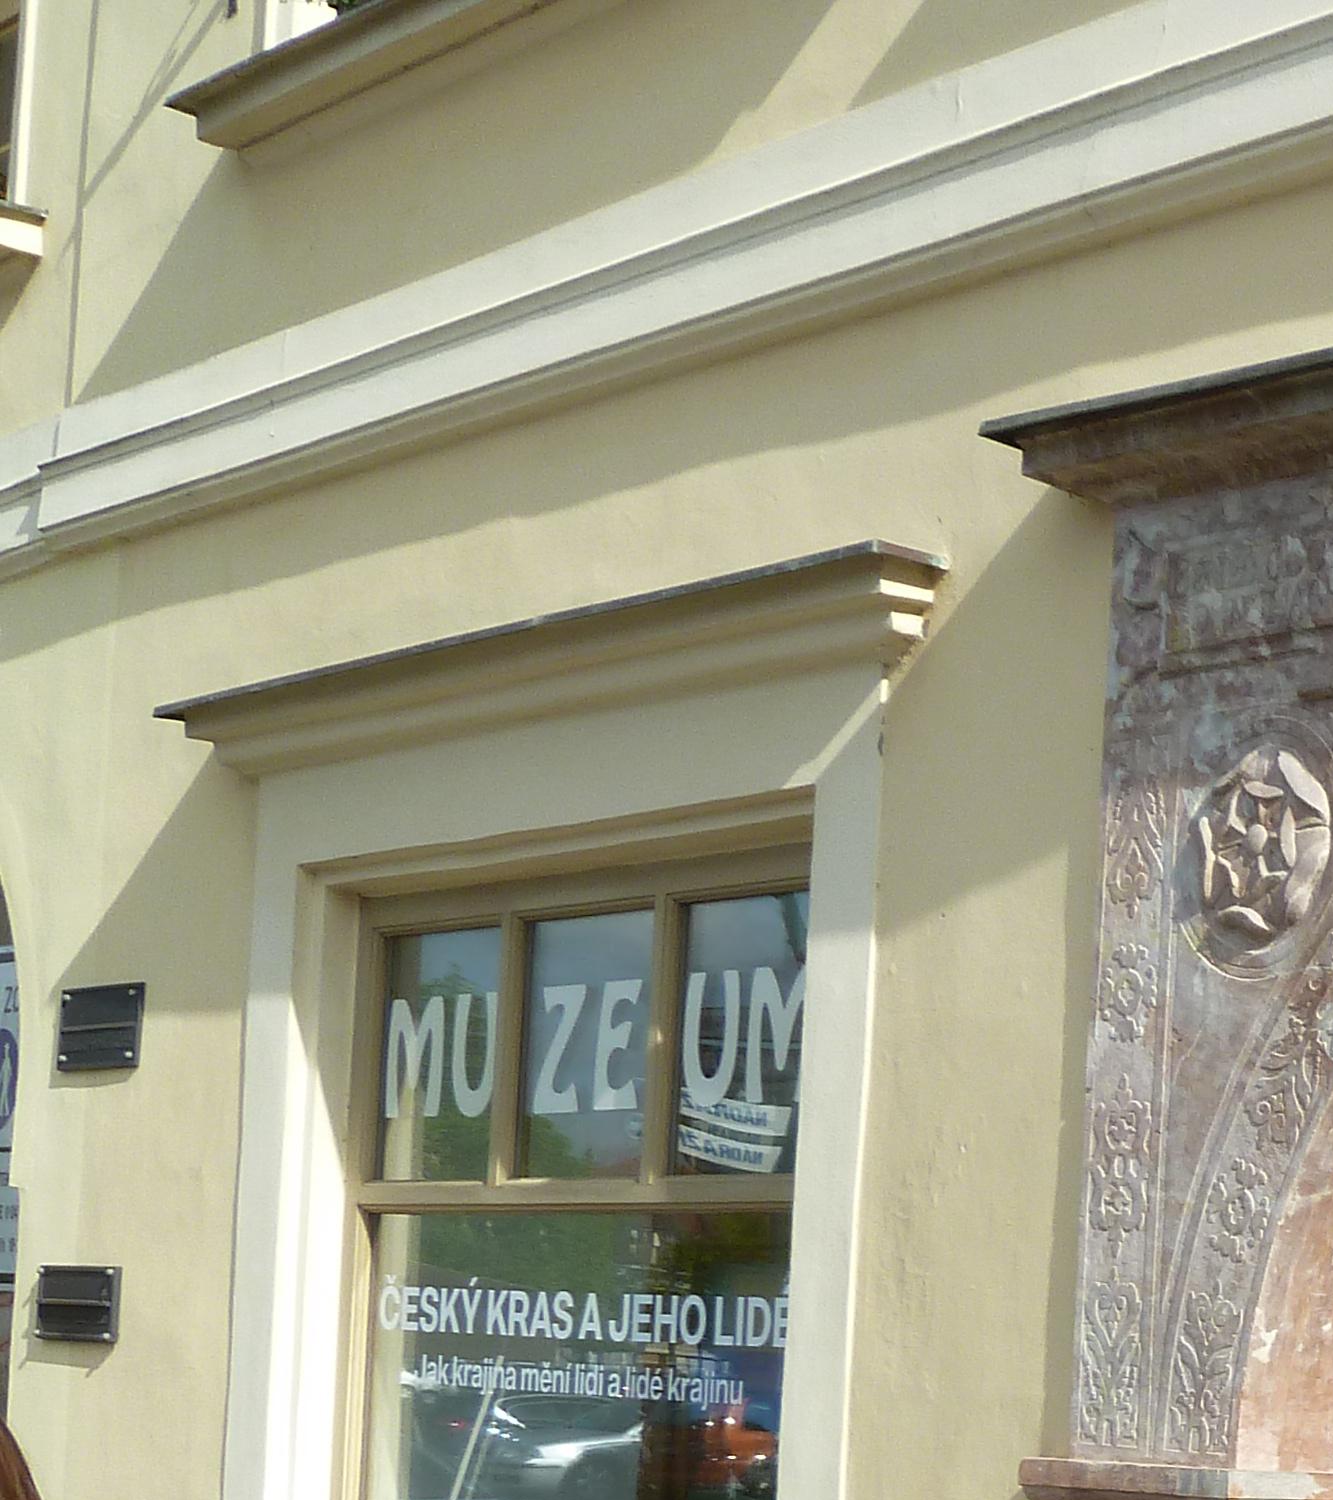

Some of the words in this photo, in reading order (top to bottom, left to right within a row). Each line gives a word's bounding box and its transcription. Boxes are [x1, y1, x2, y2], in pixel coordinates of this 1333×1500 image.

[380, 1274, 482, 1334] ČESKÝ
[486, 1289, 574, 1340] KRAS
[578, 1293, 603, 1340] A
[608, 1293, 707, 1345] JEHO
[415, 1354, 449, 1385] Jak
[452, 1356, 517, 1395] krajina
[520, 1362, 571, 1394] mění
[574, 1363, 604, 1396] lidi
[607, 1372, 622, 1397] a
[625, 1366, 663, 1400] lidé
[667, 1368, 744, 1411] krajinu
